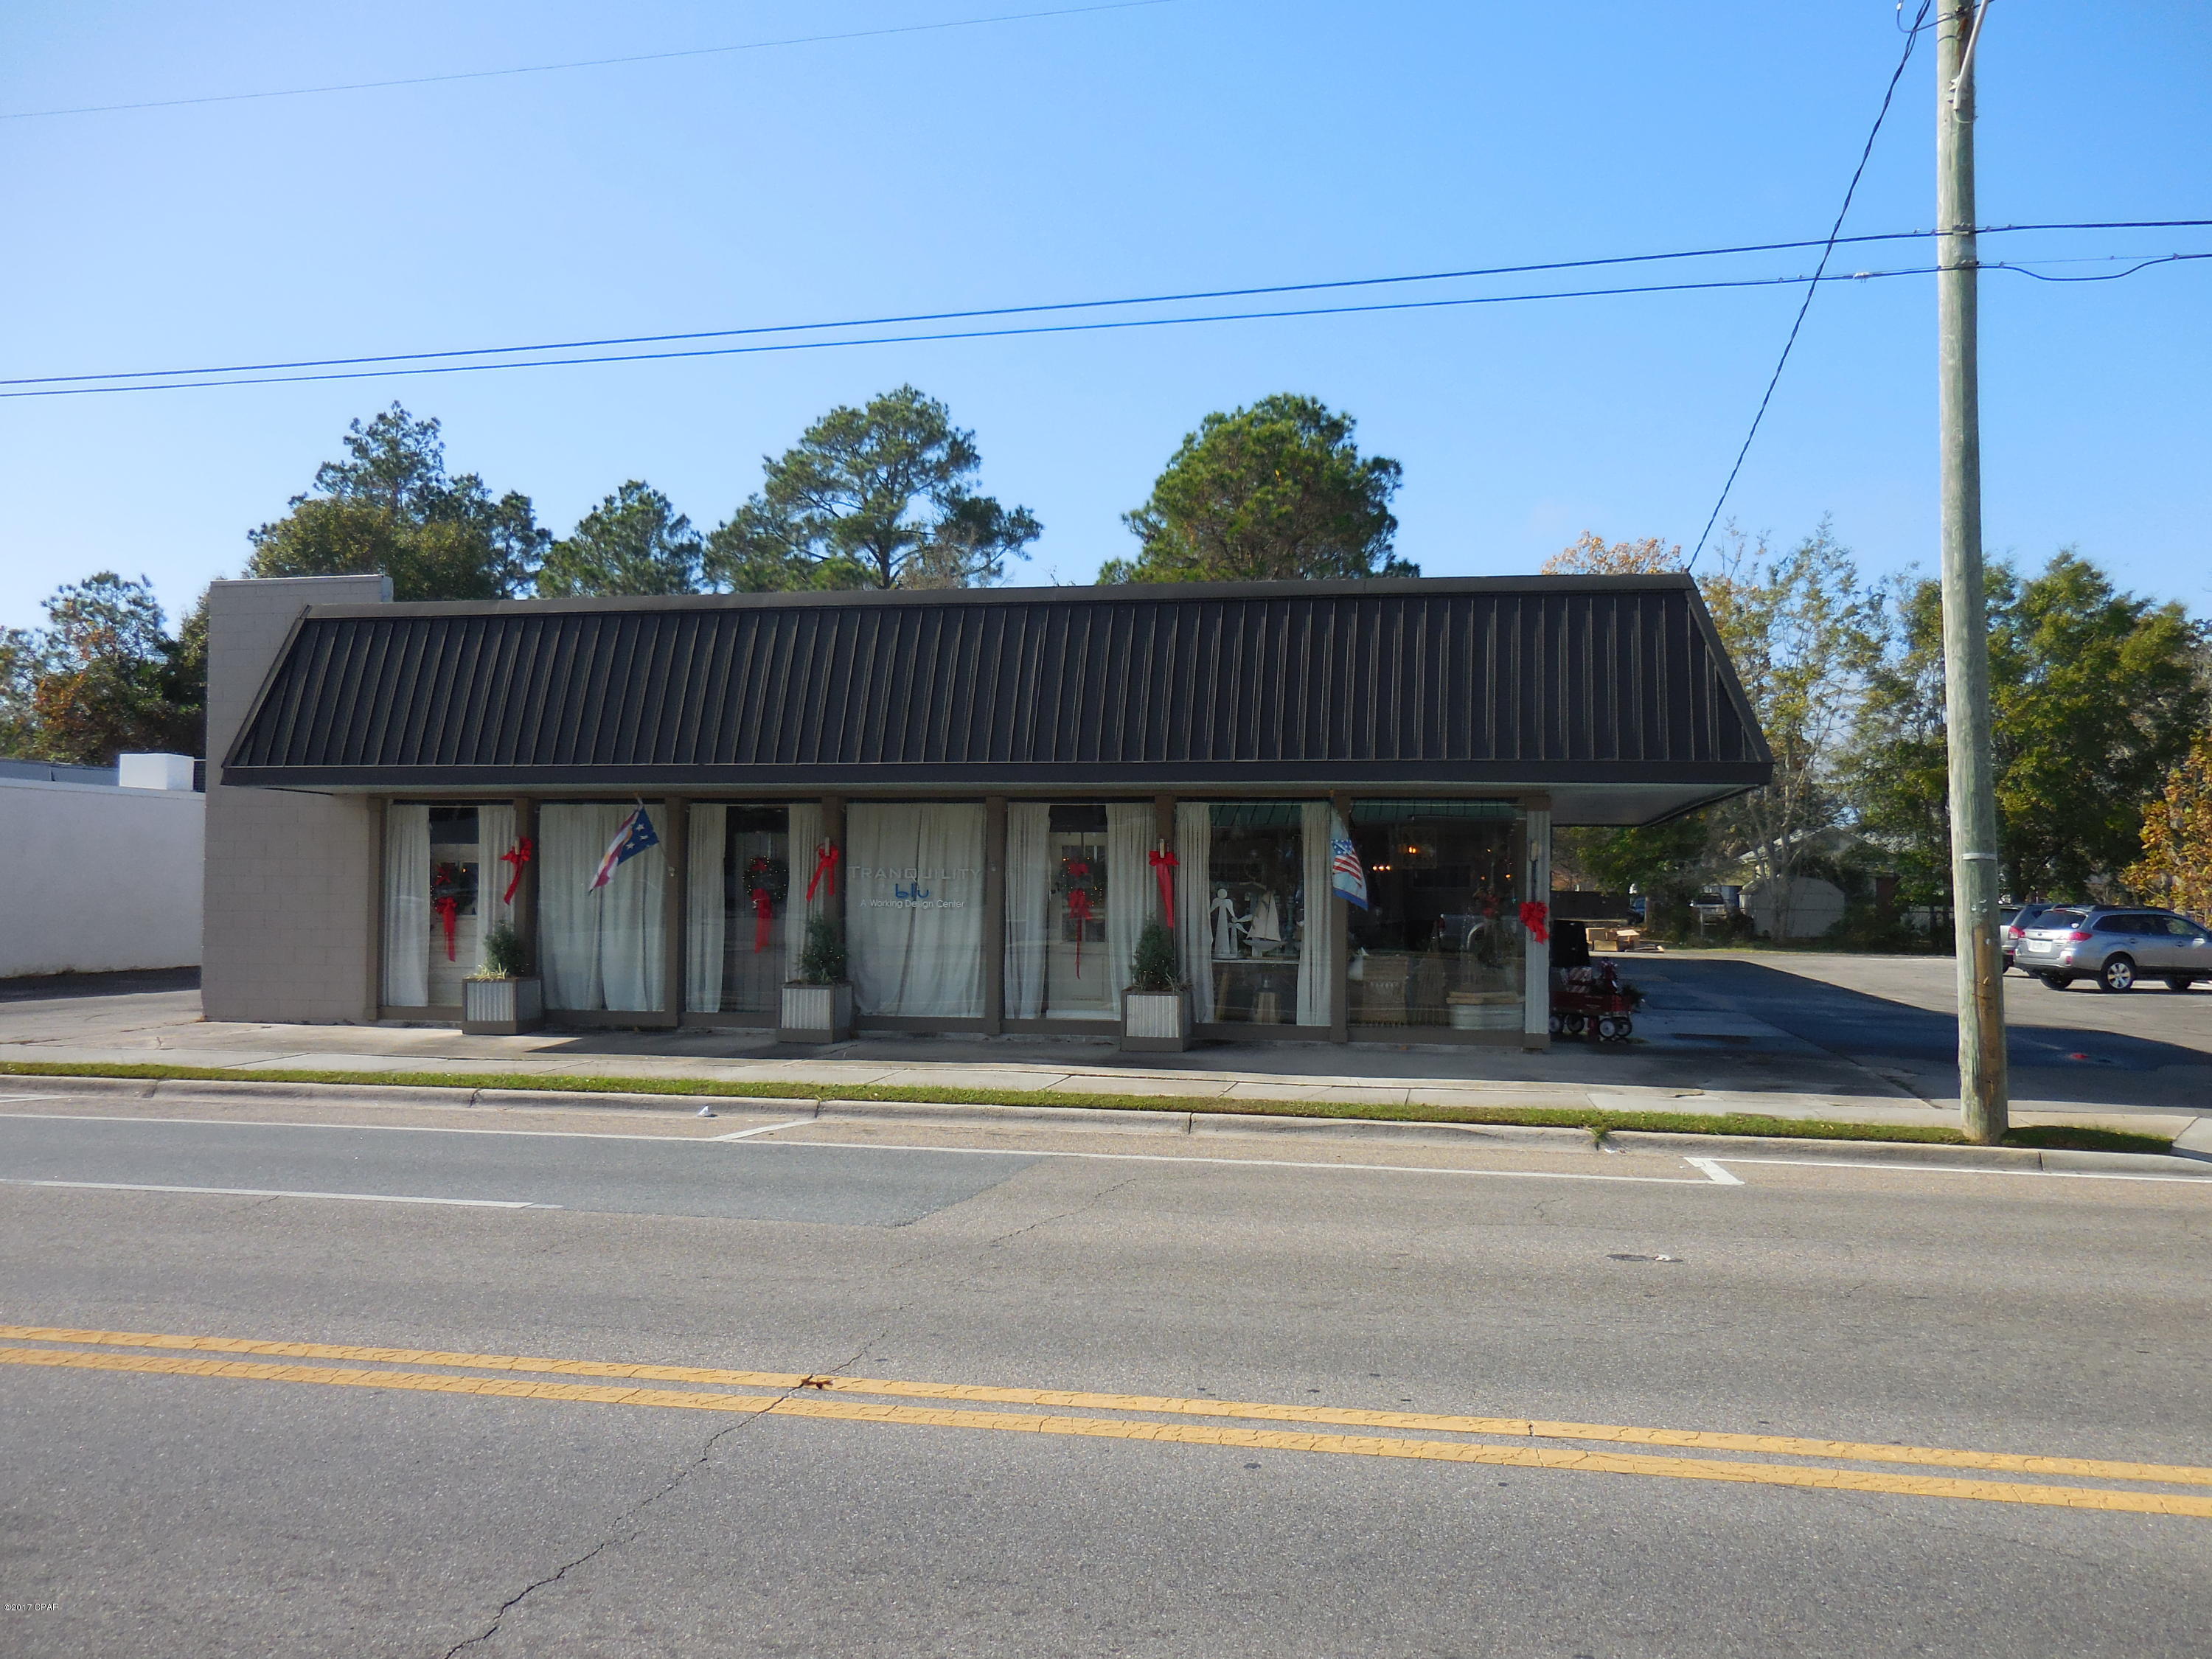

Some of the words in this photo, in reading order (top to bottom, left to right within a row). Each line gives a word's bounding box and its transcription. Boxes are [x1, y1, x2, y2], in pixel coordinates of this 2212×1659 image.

[847, 866, 981, 883] TRANQUILITY
[895, 883, 930, 899] blu
[860, 899, 867, 908] A
[870, 900, 903, 909] Working
[905, 900, 934, 909] Degn
[936, 900, 965, 908] Center
